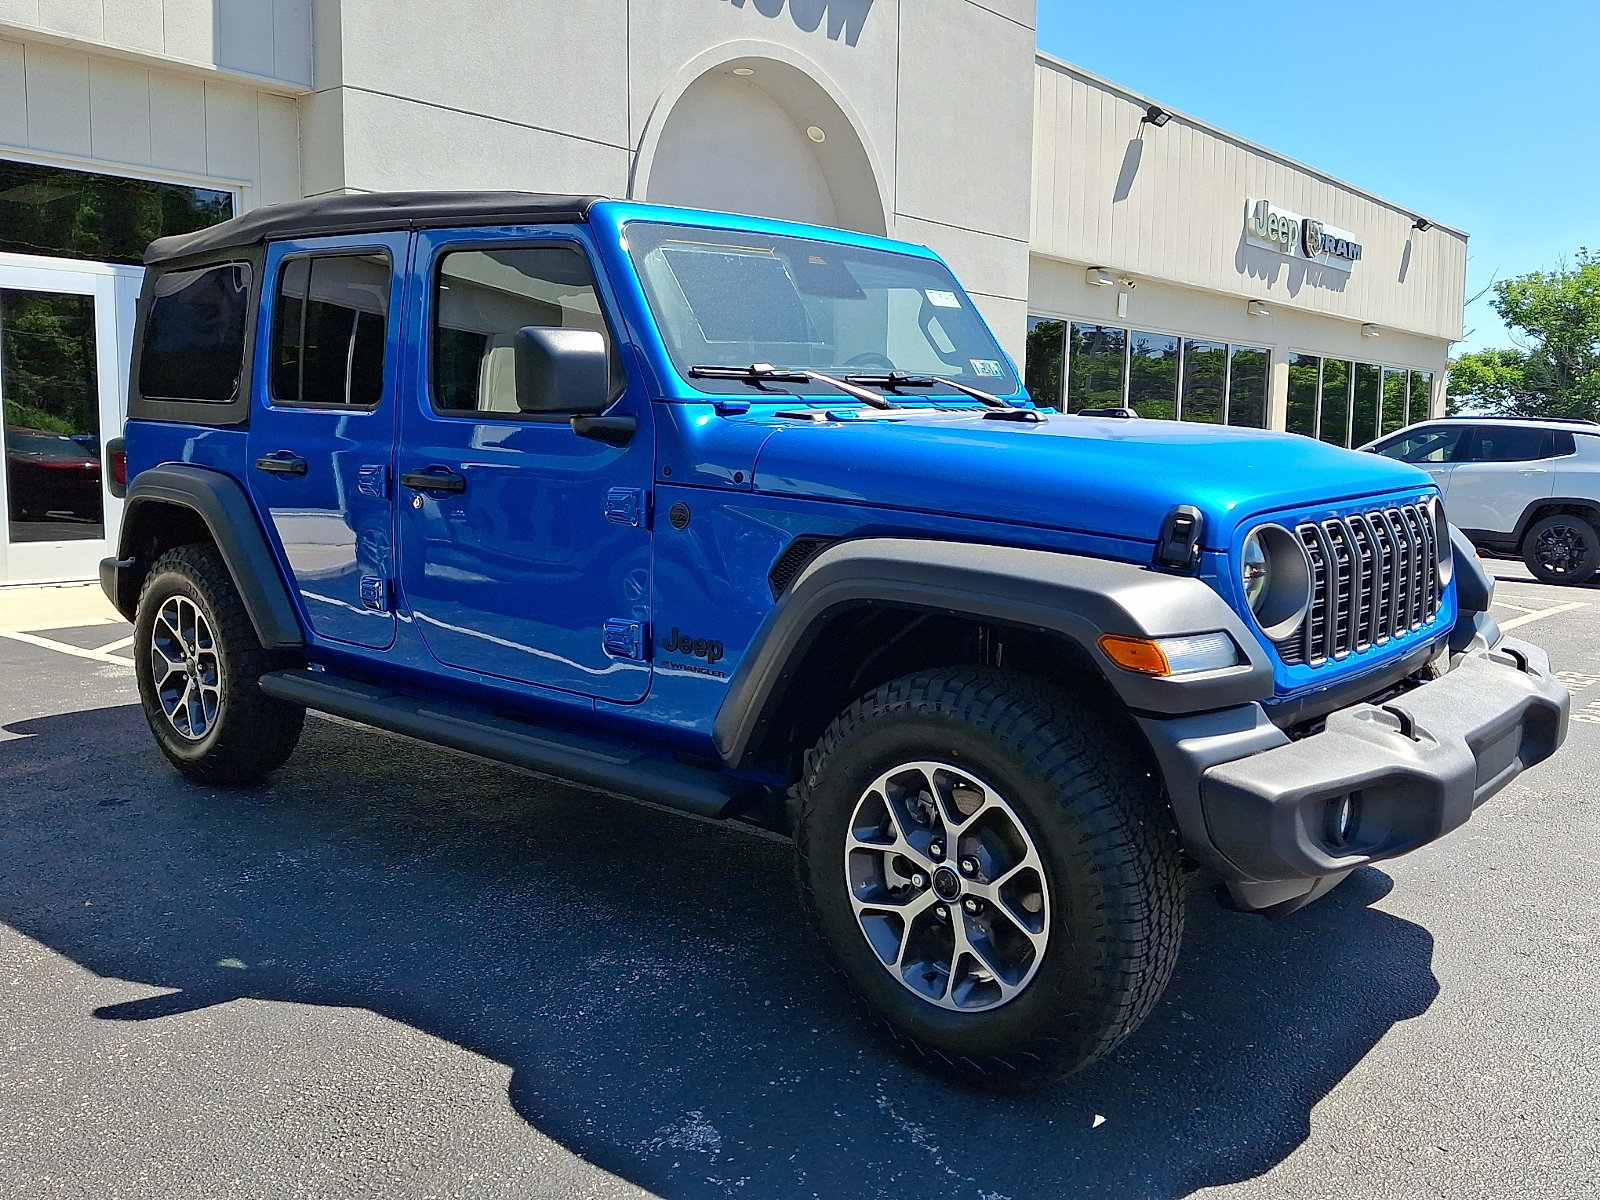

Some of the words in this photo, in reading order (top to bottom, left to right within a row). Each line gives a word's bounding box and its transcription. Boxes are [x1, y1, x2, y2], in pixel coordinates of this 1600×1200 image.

[1254, 200, 1299, 254] Jeep
[1323, 233, 1362, 260] RAM
[662, 627, 724, 665] Jeep
[670, 661, 726, 679] WRANGLER
